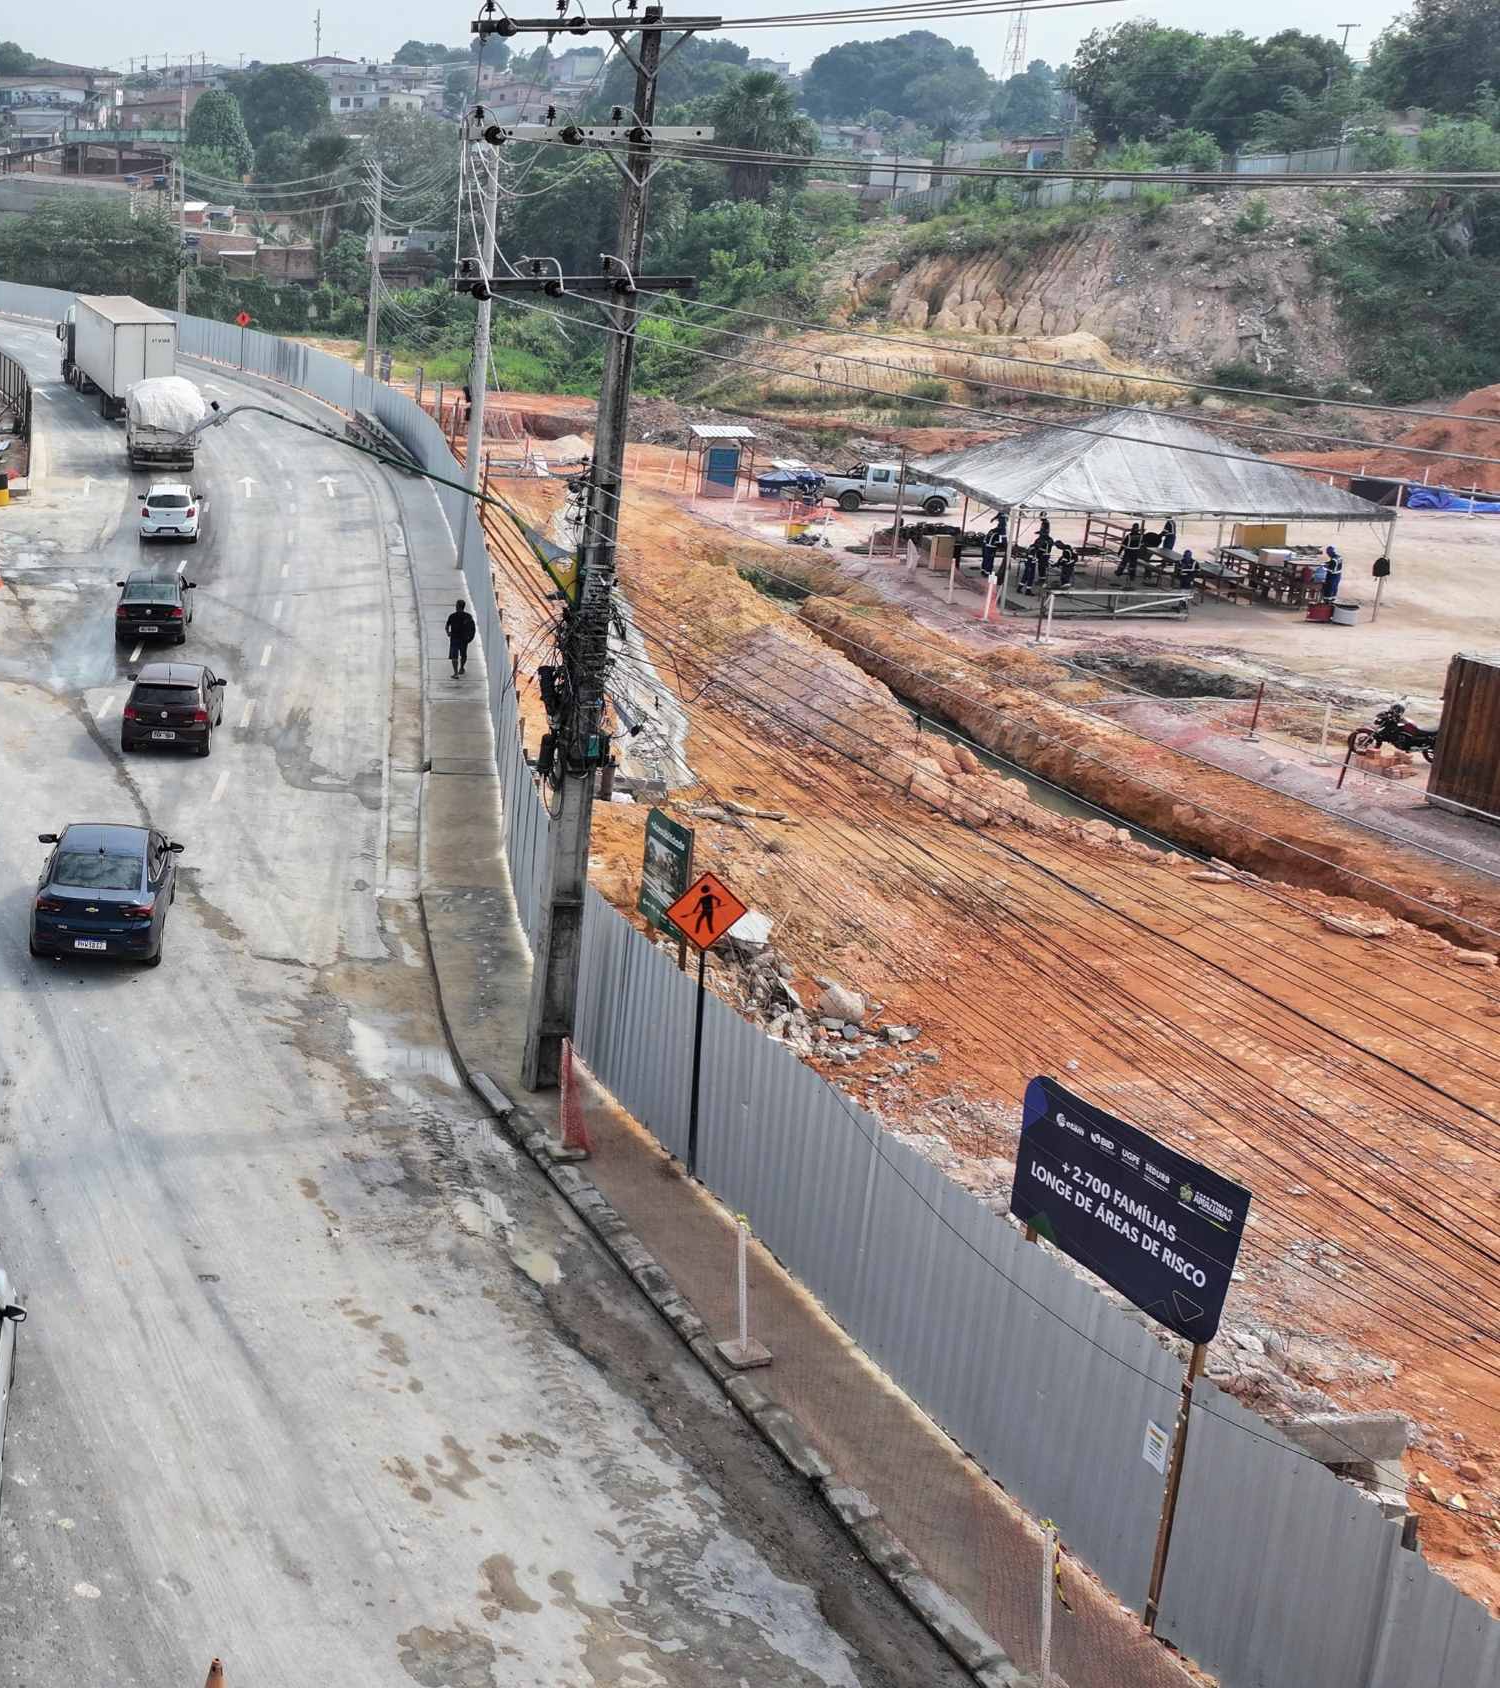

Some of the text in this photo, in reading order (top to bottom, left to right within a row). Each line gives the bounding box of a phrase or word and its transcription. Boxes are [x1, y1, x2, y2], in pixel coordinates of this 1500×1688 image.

[1030, 1160, 1207, 1289] LONGE DE ÁREAS DE RISCO
[1071, 1165, 1112, 1199] 2.700
[1113, 1188, 1178, 1243] FAMÍLIAS
